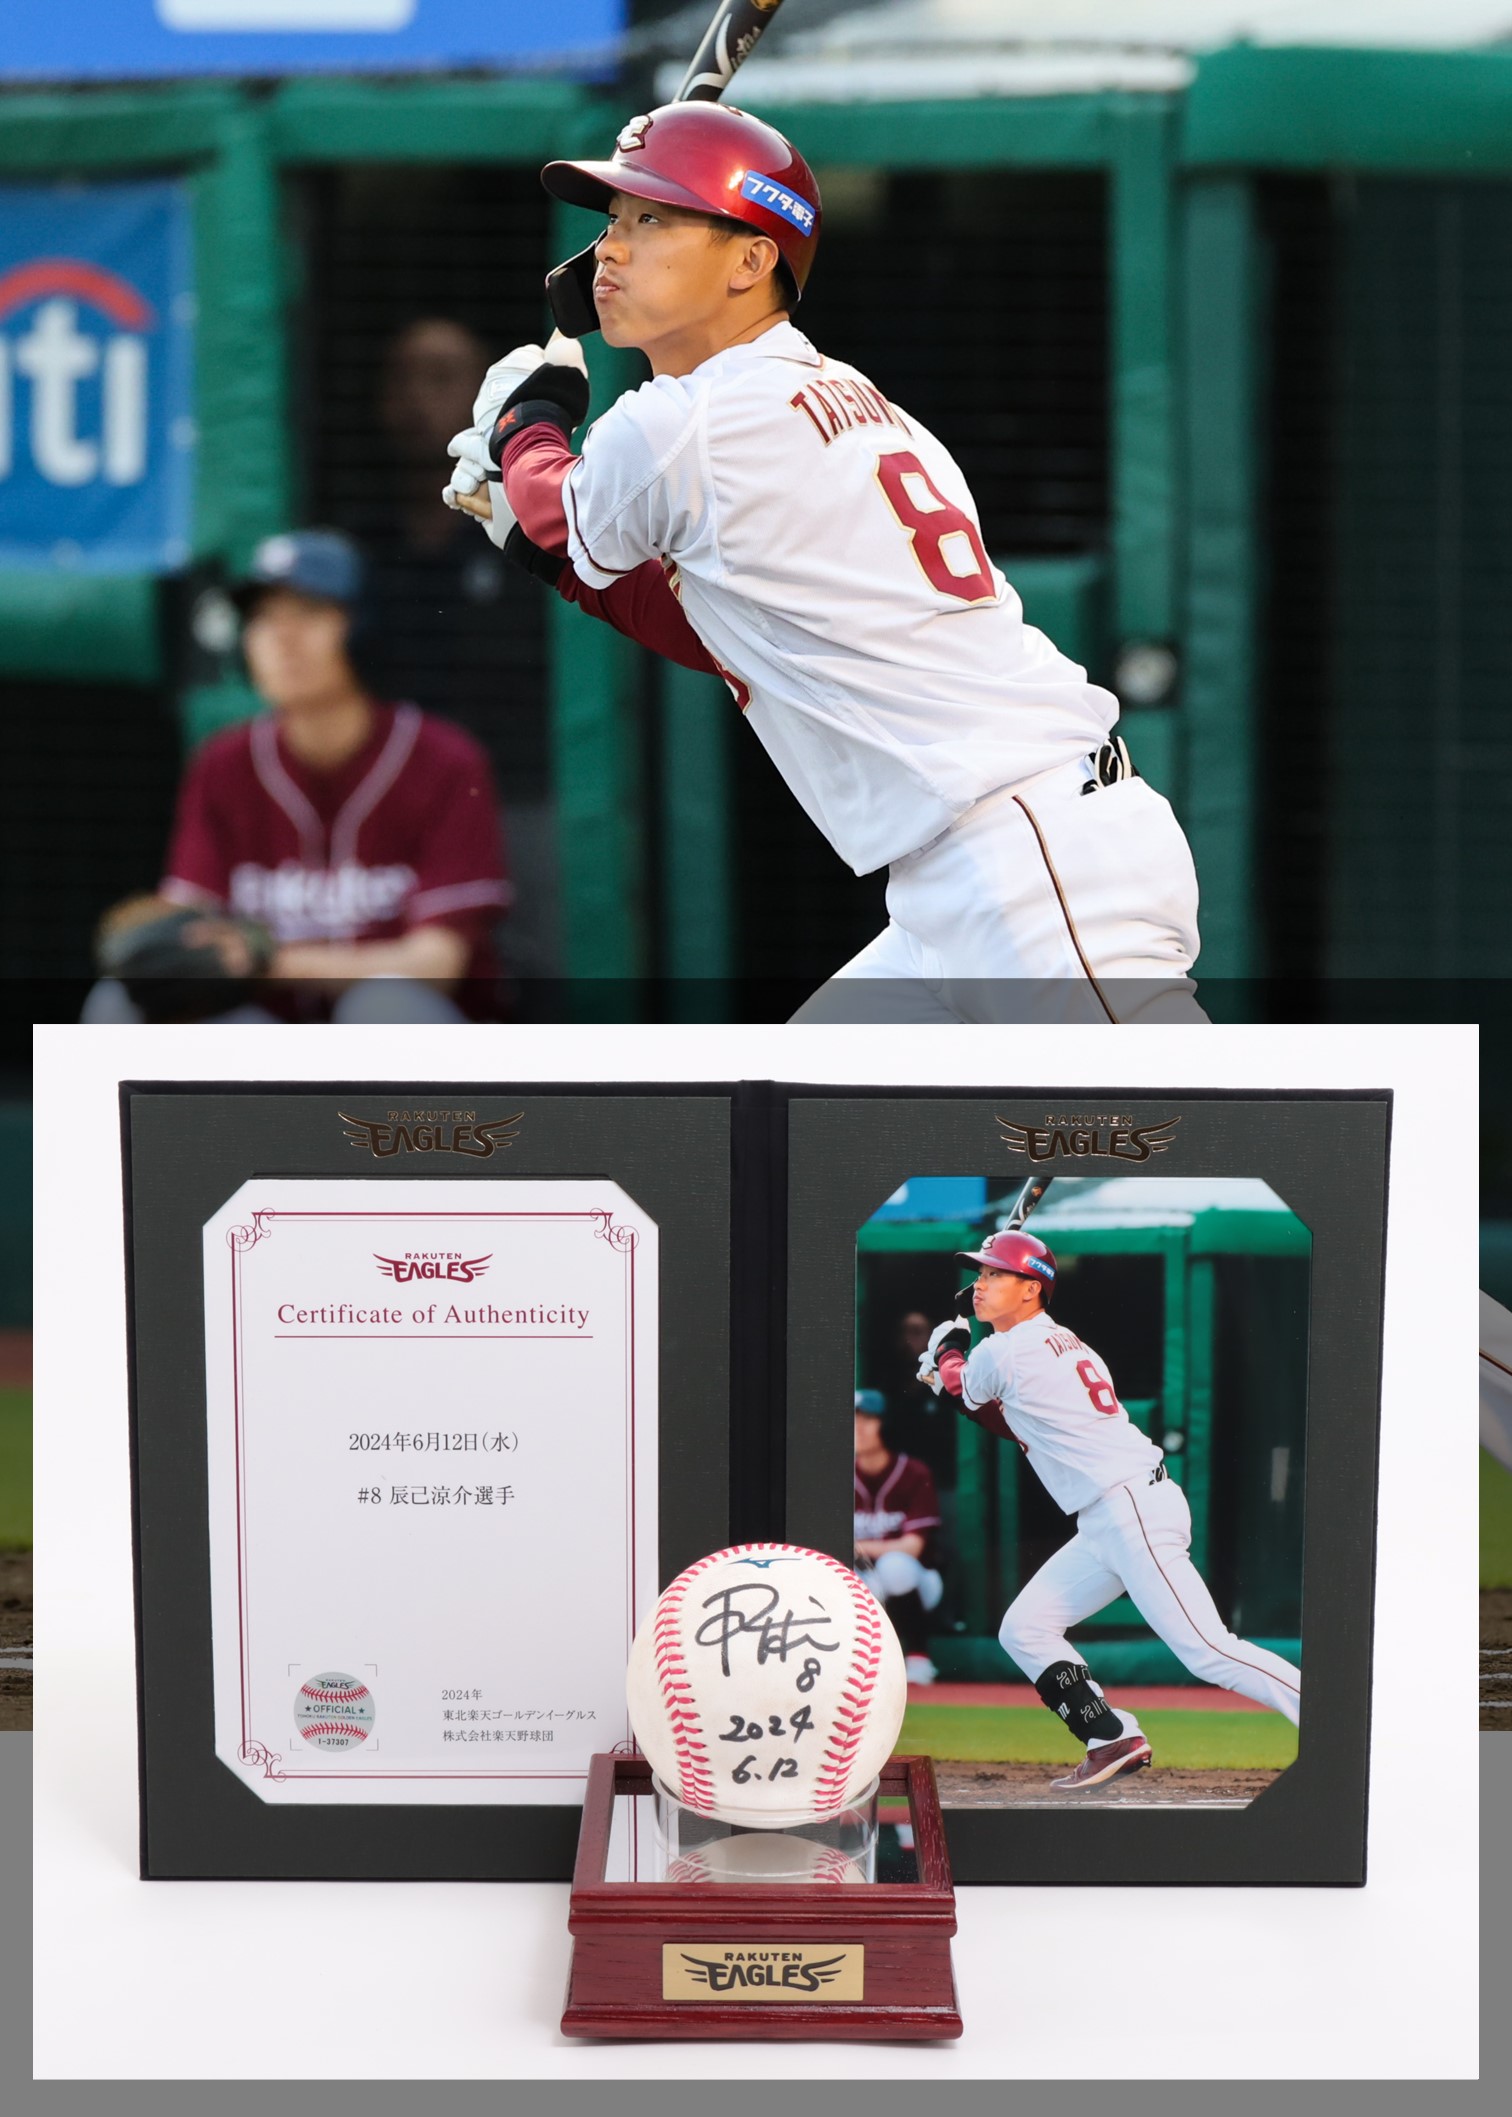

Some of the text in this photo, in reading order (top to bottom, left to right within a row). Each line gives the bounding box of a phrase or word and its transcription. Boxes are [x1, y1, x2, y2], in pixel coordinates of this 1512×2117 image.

[0, 297, 148, 487] ti
[873, 450, 1000, 606] 8
[387, 1111, 476, 1122] RAKUTEN
[1045, 1115, 1133, 1126] RAKUTEN
[368, 1124, 496, 1158] EAGLES
[1026, 1128, 1152, 1162] EAGLES
[405, 1252, 462, 1260] RAKUTEN
[393, 1261, 475, 1283] EAGLES
[277, 1303, 590, 1329] Certificate of Authenticity
[1076, 1359, 1119, 1415] 8
[349, 1431, 519, 1453] 2024年6月12日(水)
[358, 1485, 515, 1506] #8 辰己涼介選手
[796, 1657, 821, 1693] 8
[441, 1688, 483, 1701] 2024年
[313, 1704, 357, 1715] OFFICIAL
[442, 1709, 597, 1722] 東北楽天ゴールデンイーグルス
[719, 1704, 815, 1744] 2024
[442, 1729, 554, 1743] 株式会社楽天野球団
[724, 1952, 803, 1962] RAKUTEN
[706, 1963, 820, 1992] EAGLES
